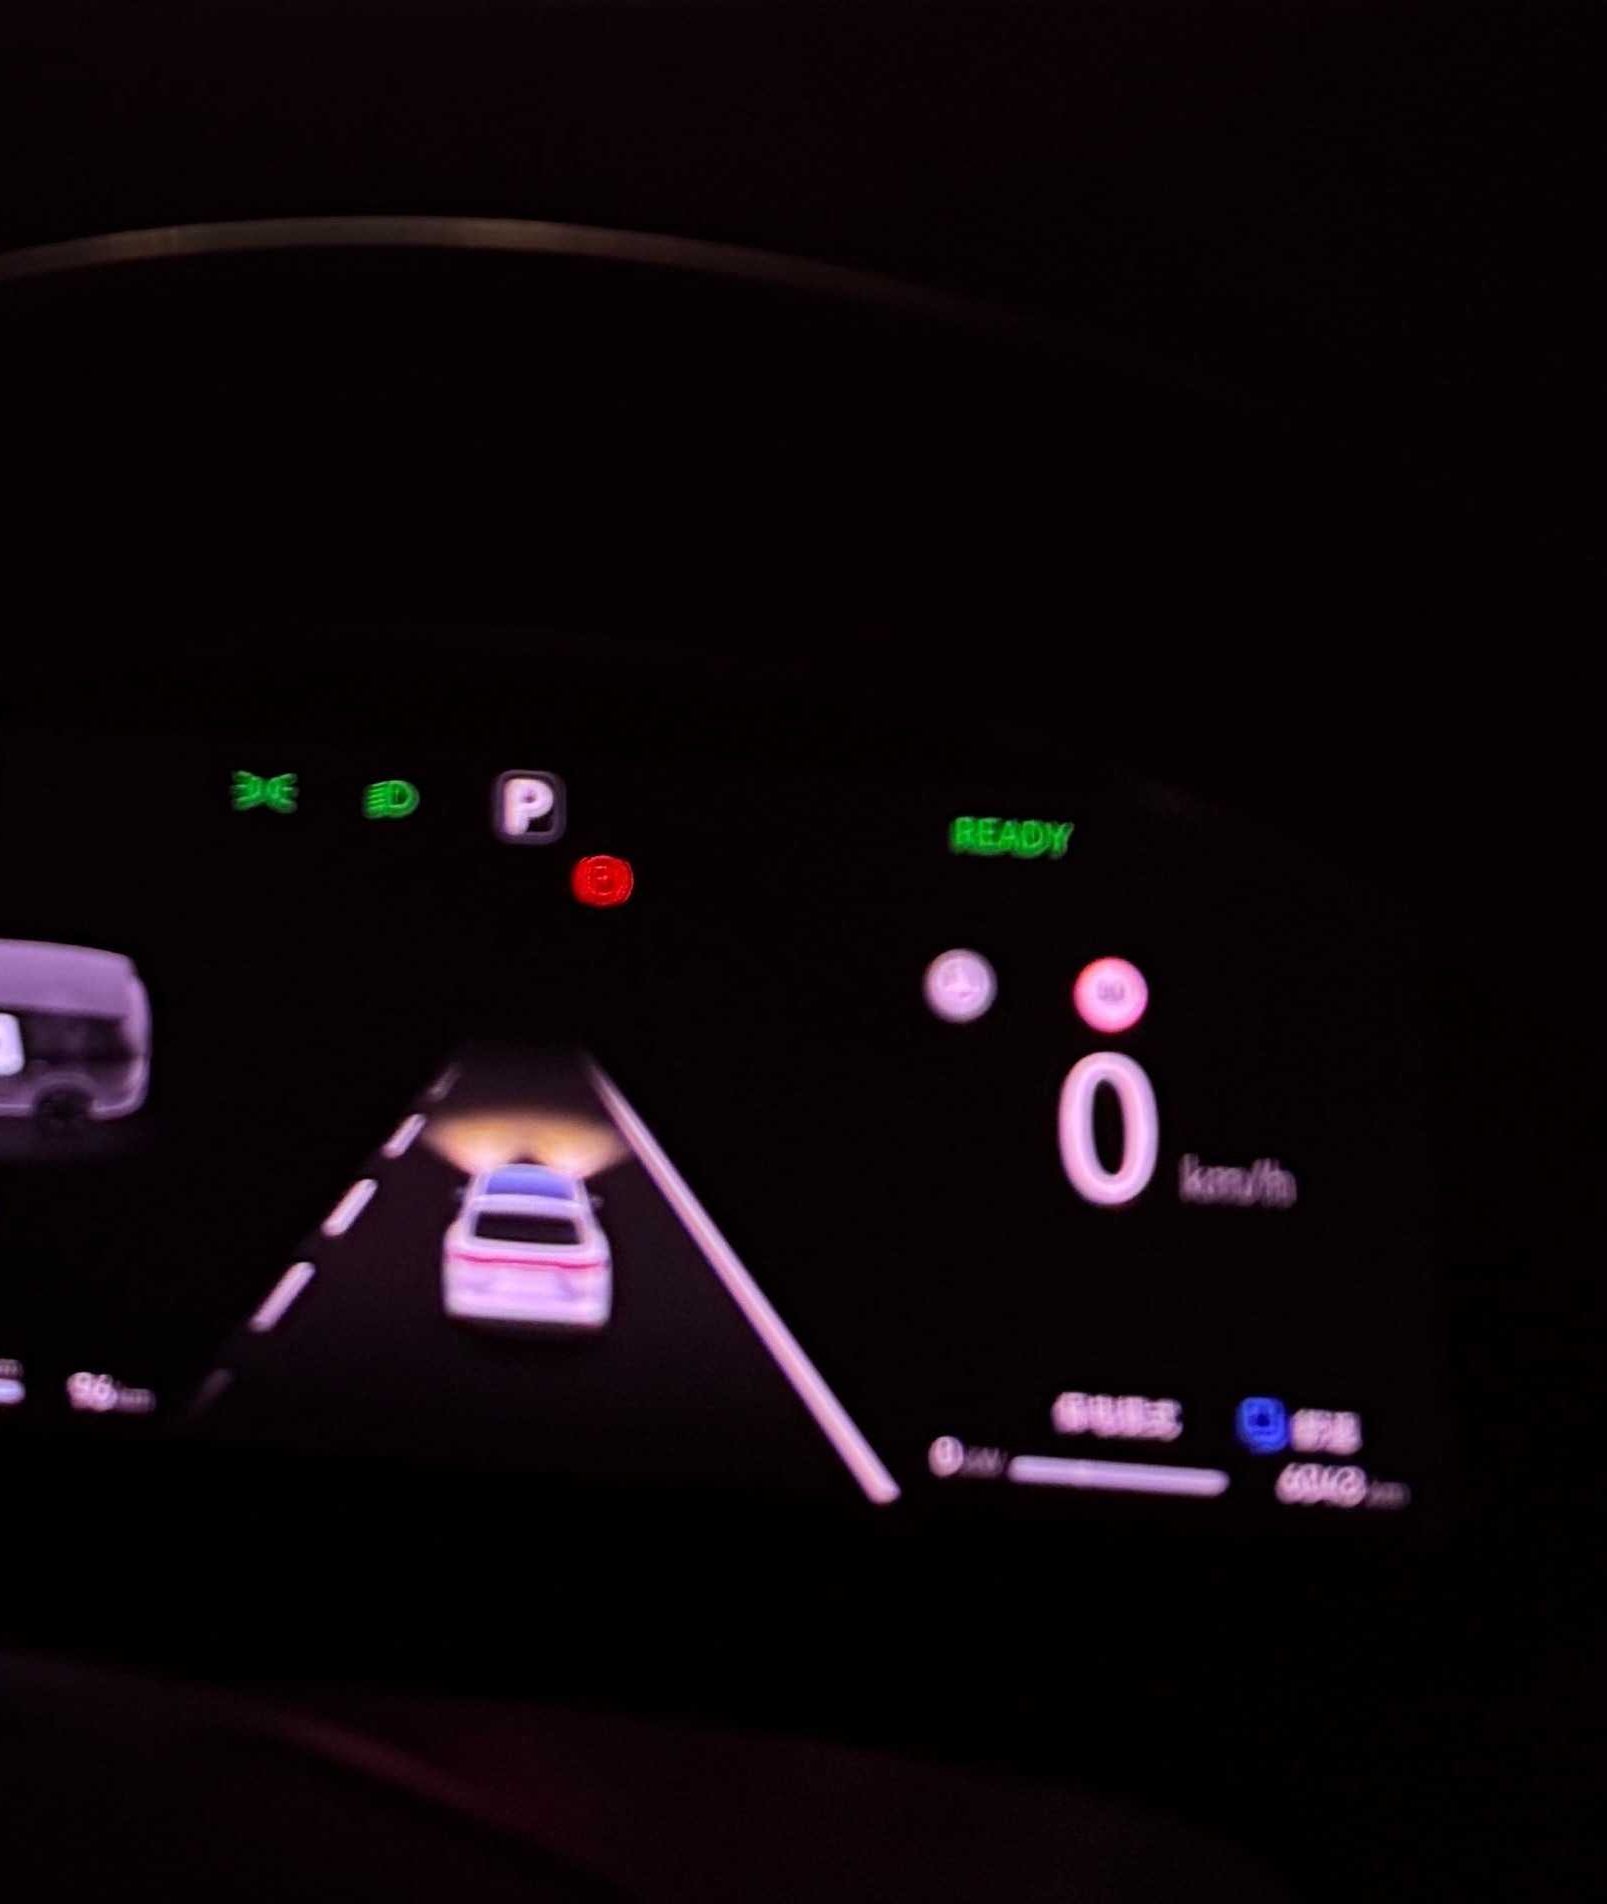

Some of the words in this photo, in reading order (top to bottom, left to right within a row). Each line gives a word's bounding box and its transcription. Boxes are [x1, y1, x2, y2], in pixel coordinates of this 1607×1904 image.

[504, 778, 554, 836] P
[950, 816, 1074, 858] READY
[1058, 1051, 1159, 1205] 0
[1178, 1153, 1297, 1208] km/h
